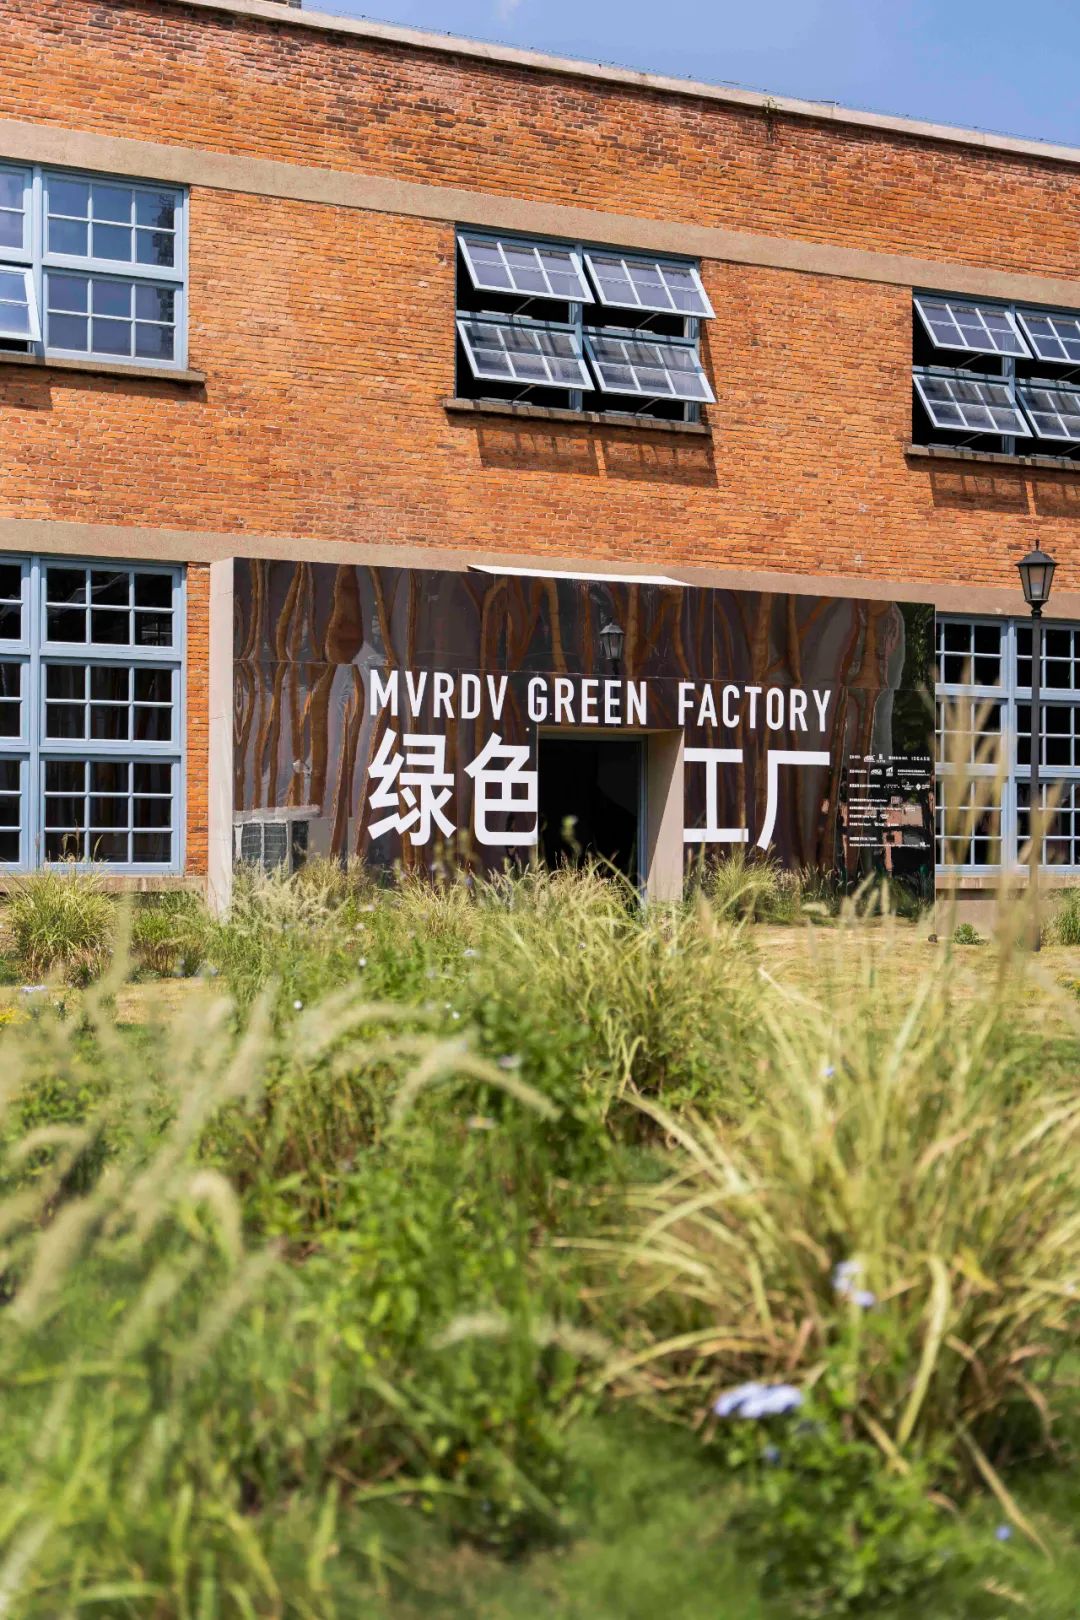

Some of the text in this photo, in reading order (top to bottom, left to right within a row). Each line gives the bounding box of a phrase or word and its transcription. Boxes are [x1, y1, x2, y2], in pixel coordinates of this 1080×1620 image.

[371, 669, 830, 732] MVRDV GREEN FACTORY
[368, 729, 830, 850] 绿色 工厂
